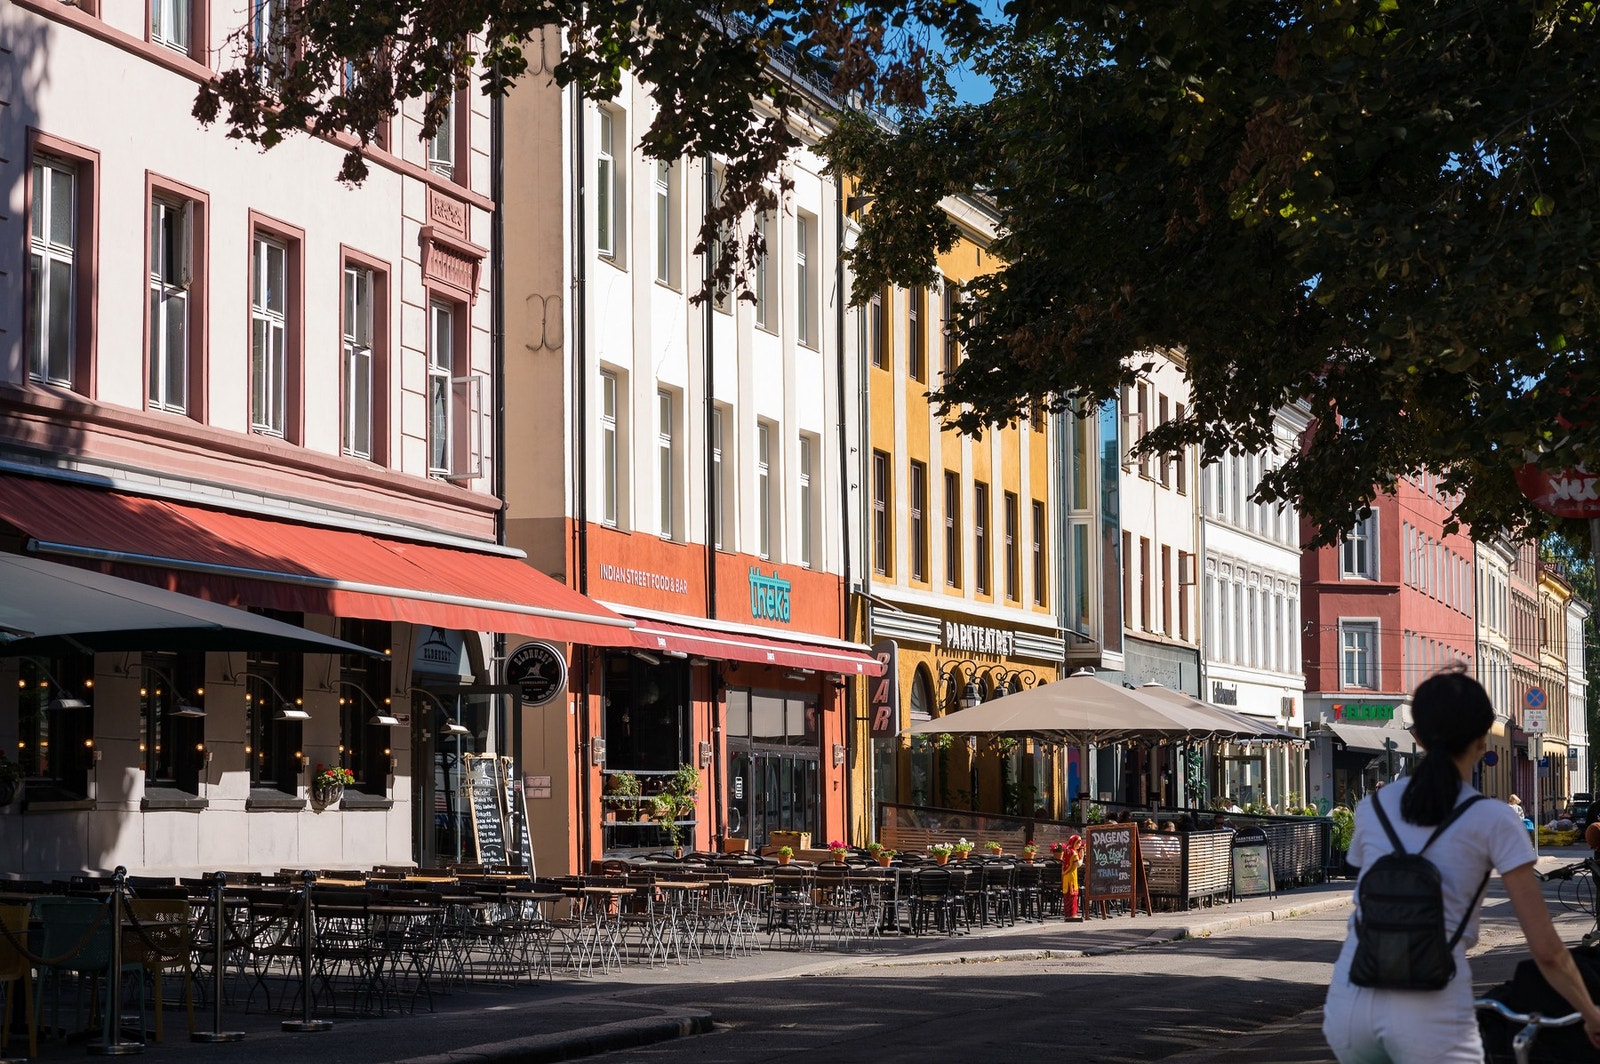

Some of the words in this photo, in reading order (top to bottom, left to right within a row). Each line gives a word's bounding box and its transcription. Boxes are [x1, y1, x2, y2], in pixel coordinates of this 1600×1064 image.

[600, 563, 626, 583] INDIAN
[626, 568, 651, 588] STREET
[651, 573, 670, 591] FOOD
[670, 577, 675, 592] &
[675, 578, 688, 595] BAR
[748, 565, 791, 623] theka
[946, 621, 1013, 656] PARKTEATRET
[513, 649, 553, 666] ELDHUSET
[872, 652, 891, 731] BAR
[1091, 831, 1130, 846] DAGENS
